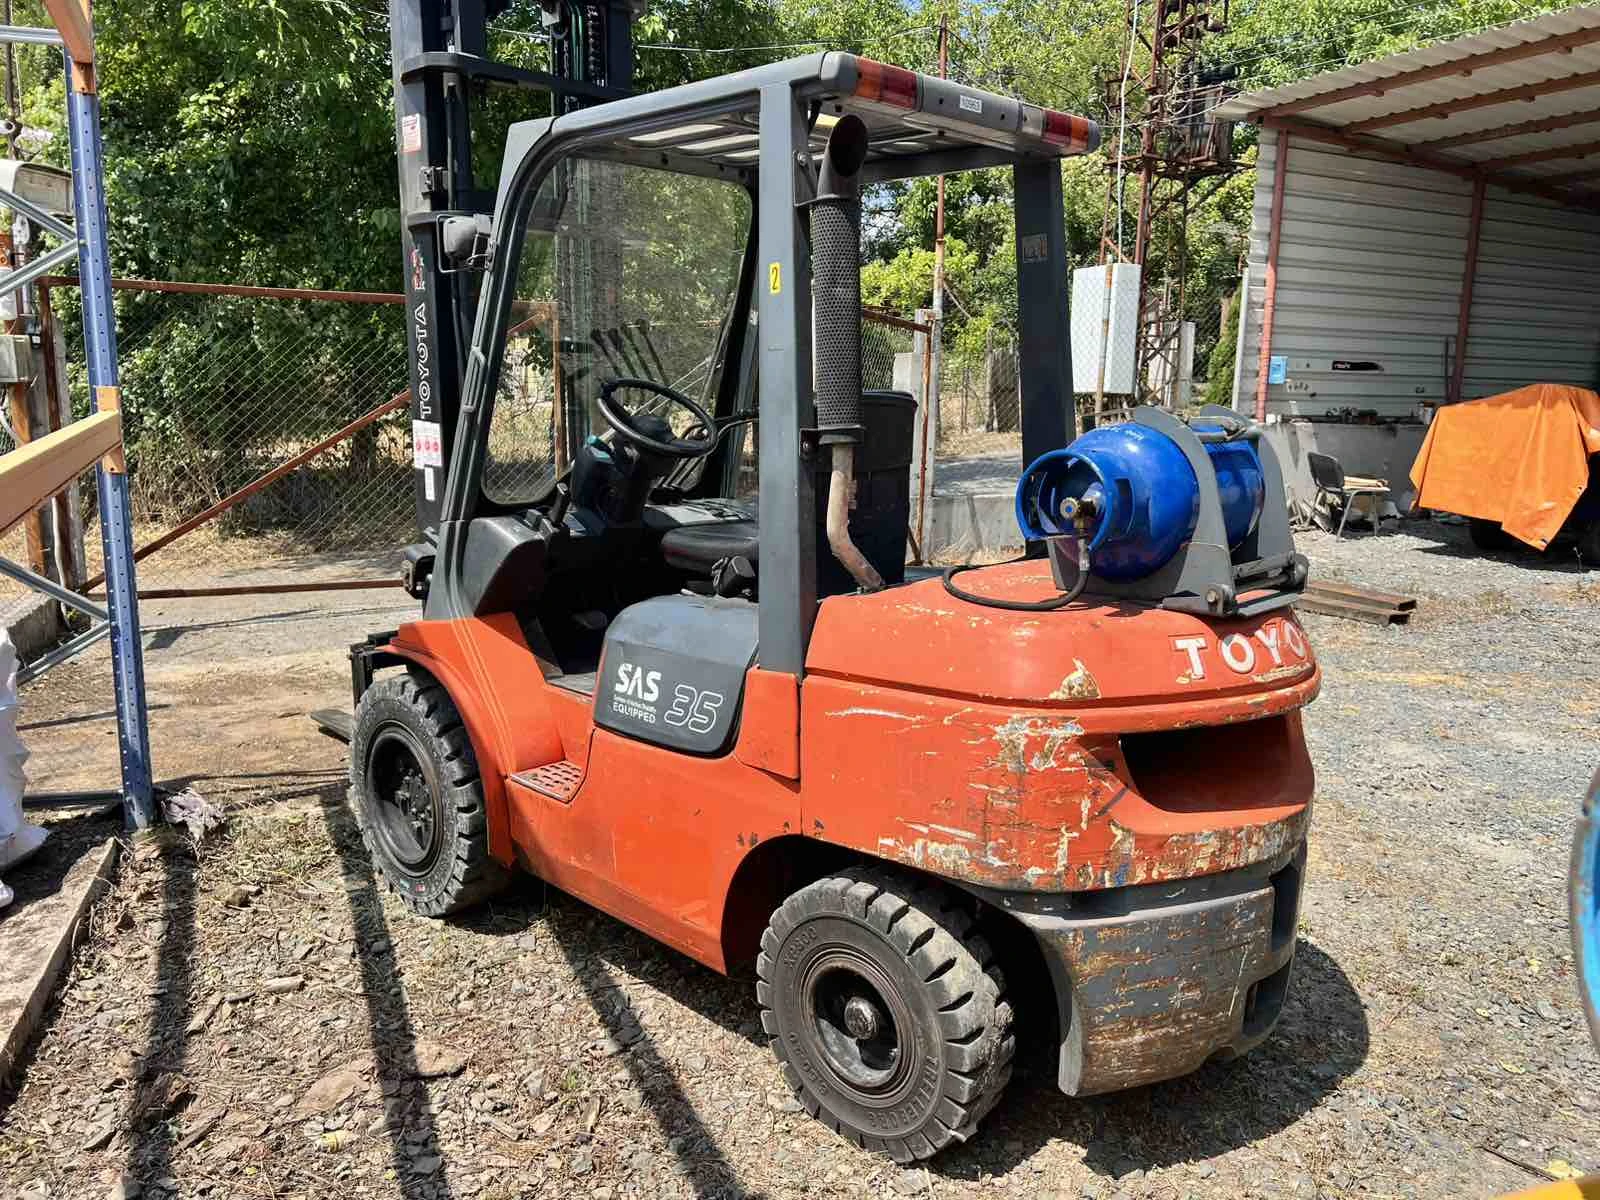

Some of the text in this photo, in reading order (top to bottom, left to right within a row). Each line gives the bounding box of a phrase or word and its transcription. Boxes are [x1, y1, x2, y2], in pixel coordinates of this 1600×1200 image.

[771, 266, 778, 290] 2
[414, 302, 432, 419] TOYOTA
[615, 663, 661, 702] SAS
[612, 702, 656, 724] EQUIPPED
[664, 684, 723, 733] 35
